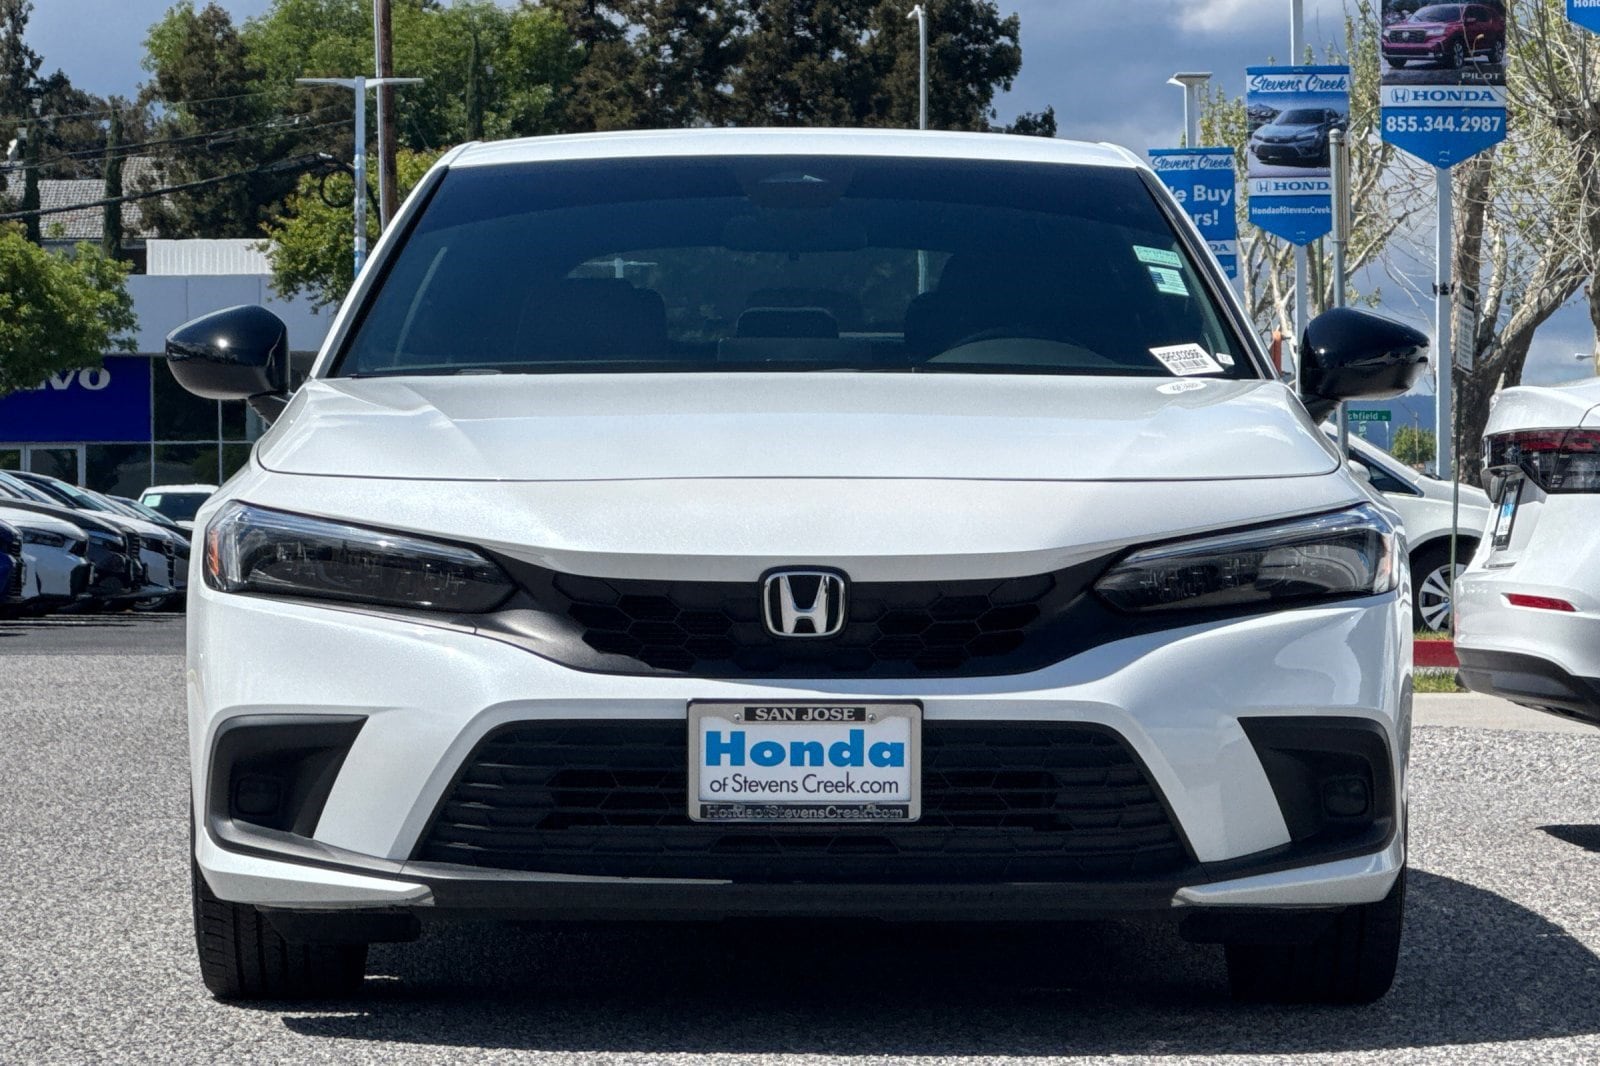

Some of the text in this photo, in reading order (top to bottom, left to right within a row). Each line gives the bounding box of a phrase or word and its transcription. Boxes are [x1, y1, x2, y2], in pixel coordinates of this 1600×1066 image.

[1249, 74, 1346, 92] Stevens Creek
[1461, 72, 1500, 80] PILOT
[1412, 90, 1496, 102] HONDA
[1386, 116, 1501, 132] 855.344.2987
[1151, 155, 1234, 169] Stevens Creek
[1274, 181, 1331, 191] HOND
[1169, 185, 1232, 206] e Buy
[1190, 209, 1219, 226] rs!
[1252, 206, 1330, 215] HondaofStevensCreek
[1348, 412, 1378, 420] chfield
[755, 707, 856, 721] SAN JOSE
[706, 729, 904, 767] Honda
[709, 772, 898, 793] of Stevens Creek.com
